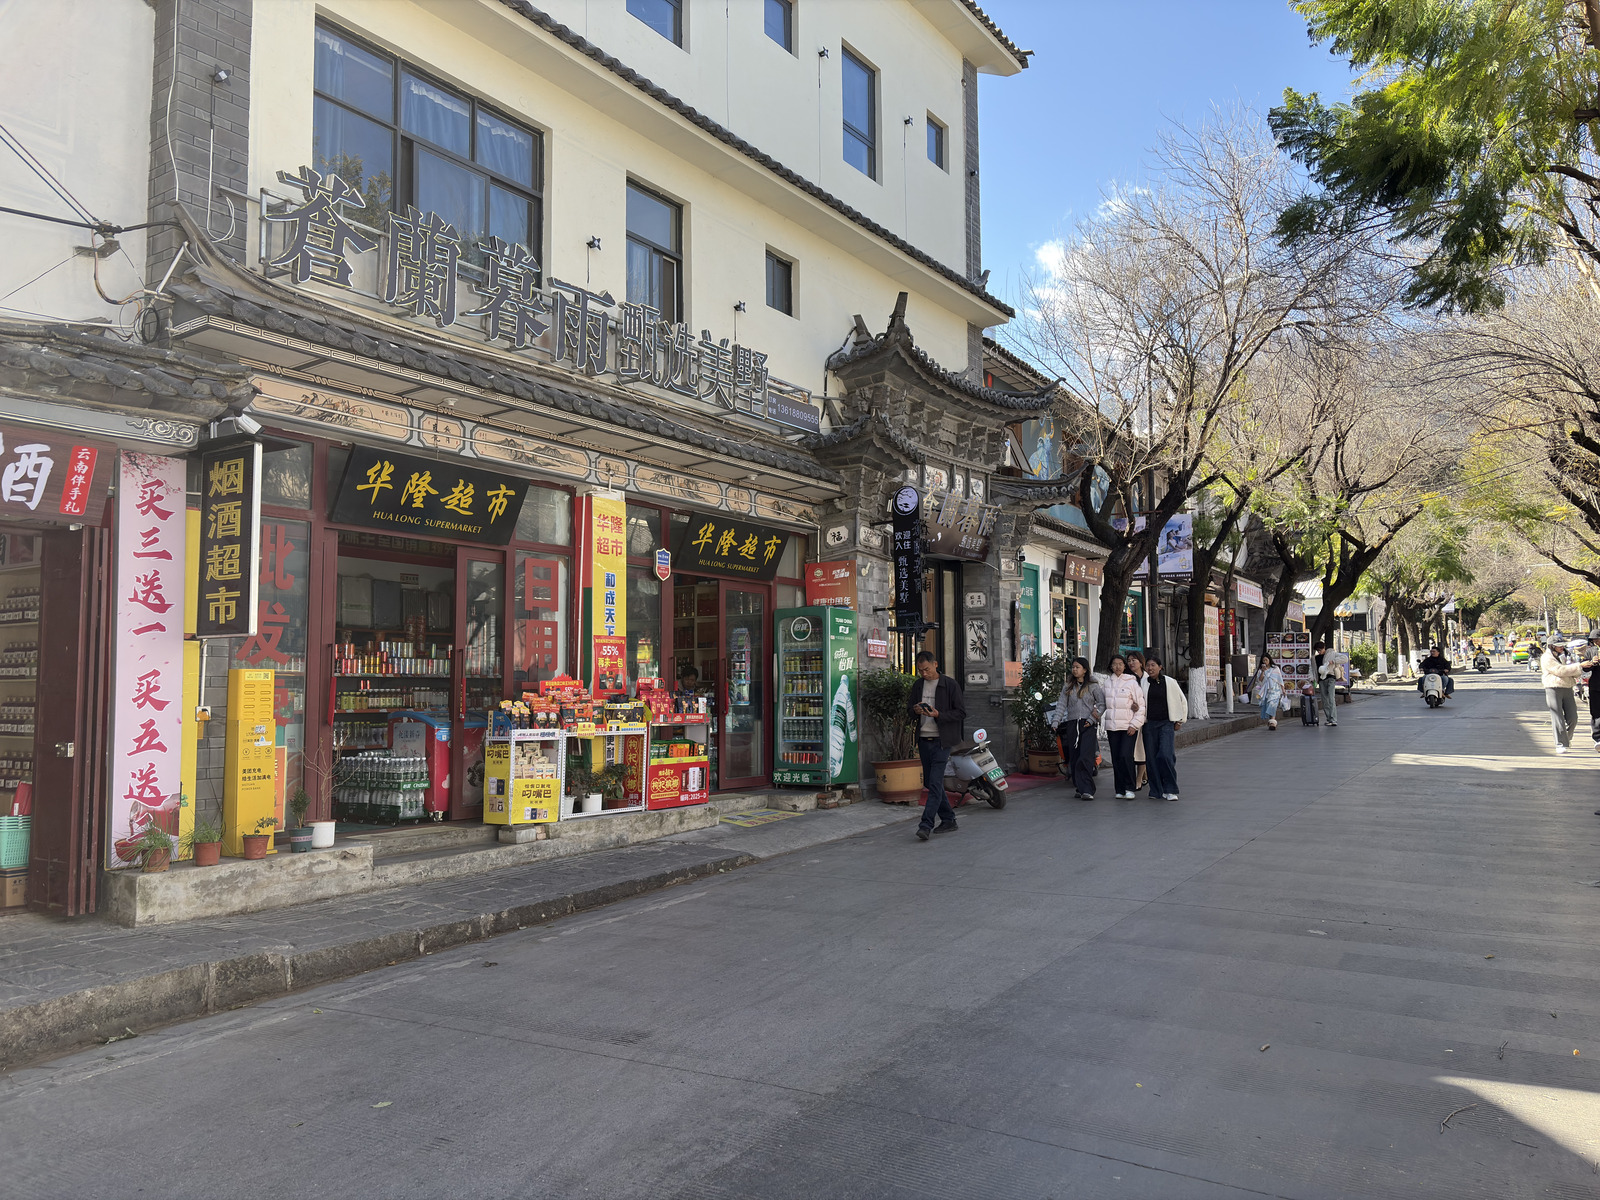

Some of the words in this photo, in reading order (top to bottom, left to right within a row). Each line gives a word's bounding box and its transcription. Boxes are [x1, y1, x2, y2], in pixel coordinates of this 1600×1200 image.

[64, 448, 91, 513] 云南伴手礼
[356, 459, 516, 524] 华隆超市
[424, 517, 482, 535] SUPERMARKET
[596, 512, 624, 536] 华隆
[205, 457, 245, 625] 烟酒超市
[692, 522, 782, 566] 华隆超市
[895, 530, 911, 540] 欢迎
[596, 535, 624, 557] 超市
[895, 541, 911, 550] 入住
[128, 477, 176, 636] 买三送一
[727, 562, 760, 574] SUPERMARKET
[604, 571, 616, 636] 和成天下
[601, 645, 619, 656] 55%
[598, 657, 624, 668] 再来一包
[487, 750, 509, 759] 叼嘴巴
[773, 772, 810, 783] 欢迎光临
[522, 789, 552, 799] 叼嘴巴
